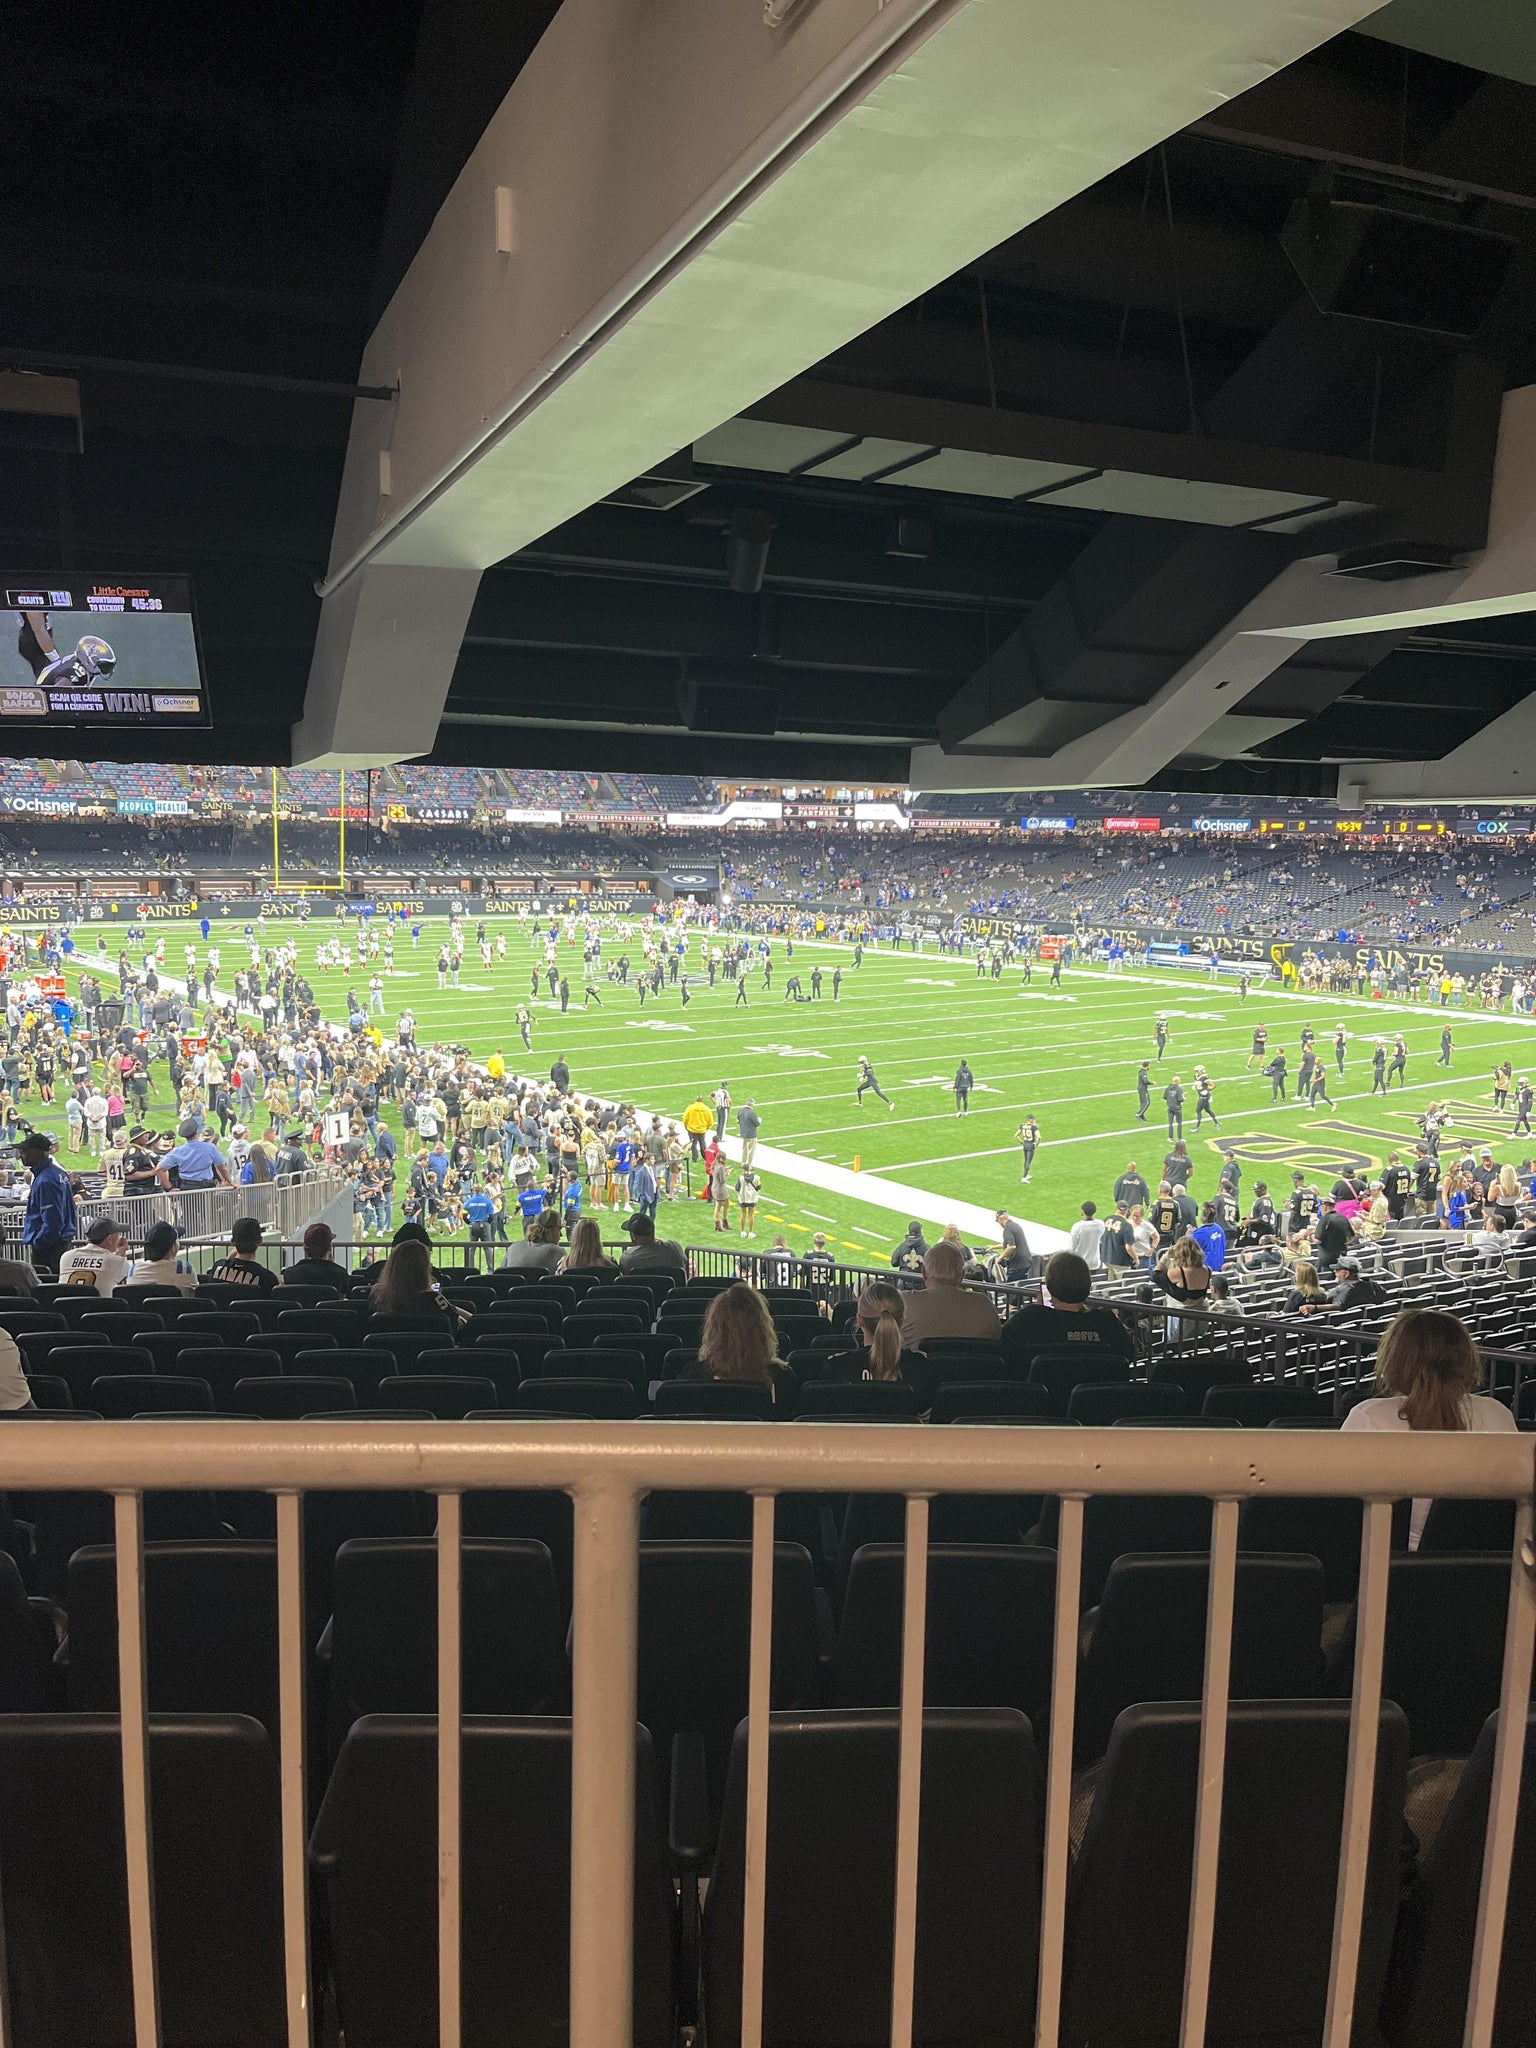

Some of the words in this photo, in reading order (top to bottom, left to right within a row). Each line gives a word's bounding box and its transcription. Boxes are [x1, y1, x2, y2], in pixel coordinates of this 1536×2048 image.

[92, 586, 115, 596] Little
[116, 587, 149, 597] Caesars
[18, 596, 44, 605] GIANTS
[87, 596, 125, 604] COUNTDOWN
[131, 598, 162, 611] 45:36
[90, 604, 98, 612] TO
[99, 604, 124, 612] KICKOFF
[49, 693, 70, 702] SCAN
[71, 694, 81, 703] QR
[82, 694, 103, 703] CODE
[104, 693, 151, 713] WIN!
[162, 699, 194, 707] Ochsner
[70, 704, 94, 712] CHANCE
[13, 798, 76, 812] Ochsner
[119, 801, 154, 811] PEOPLES
[156, 801, 187, 812] HEALTH
[389, 806, 405, 818] 25
[418, 809, 469, 819] CAESARS
[475, 809, 503, 817] SAINTS
[1039, 820, 1067, 828] Allstate
[1201, 820, 1248, 831] Ochsner
[1477, 822, 1508, 833] COX
[486, 901, 530, 912] SAINTS
[589, 900, 628, 911] SAINT
[0, 907, 60, 920] SAINTS
[335, 1119, 343, 1139] 1
[109, 1164, 124, 1181] 41
[1429, 1168, 1437, 1182] 7
[1397, 1179, 1408, 1194] 12
[1105, 1218, 1122, 1233] 44
[1160, 1211, 1173, 1231] 9
[71, 1258, 103, 1268] BREES
[213, 1265, 260, 1286] KAMARA
